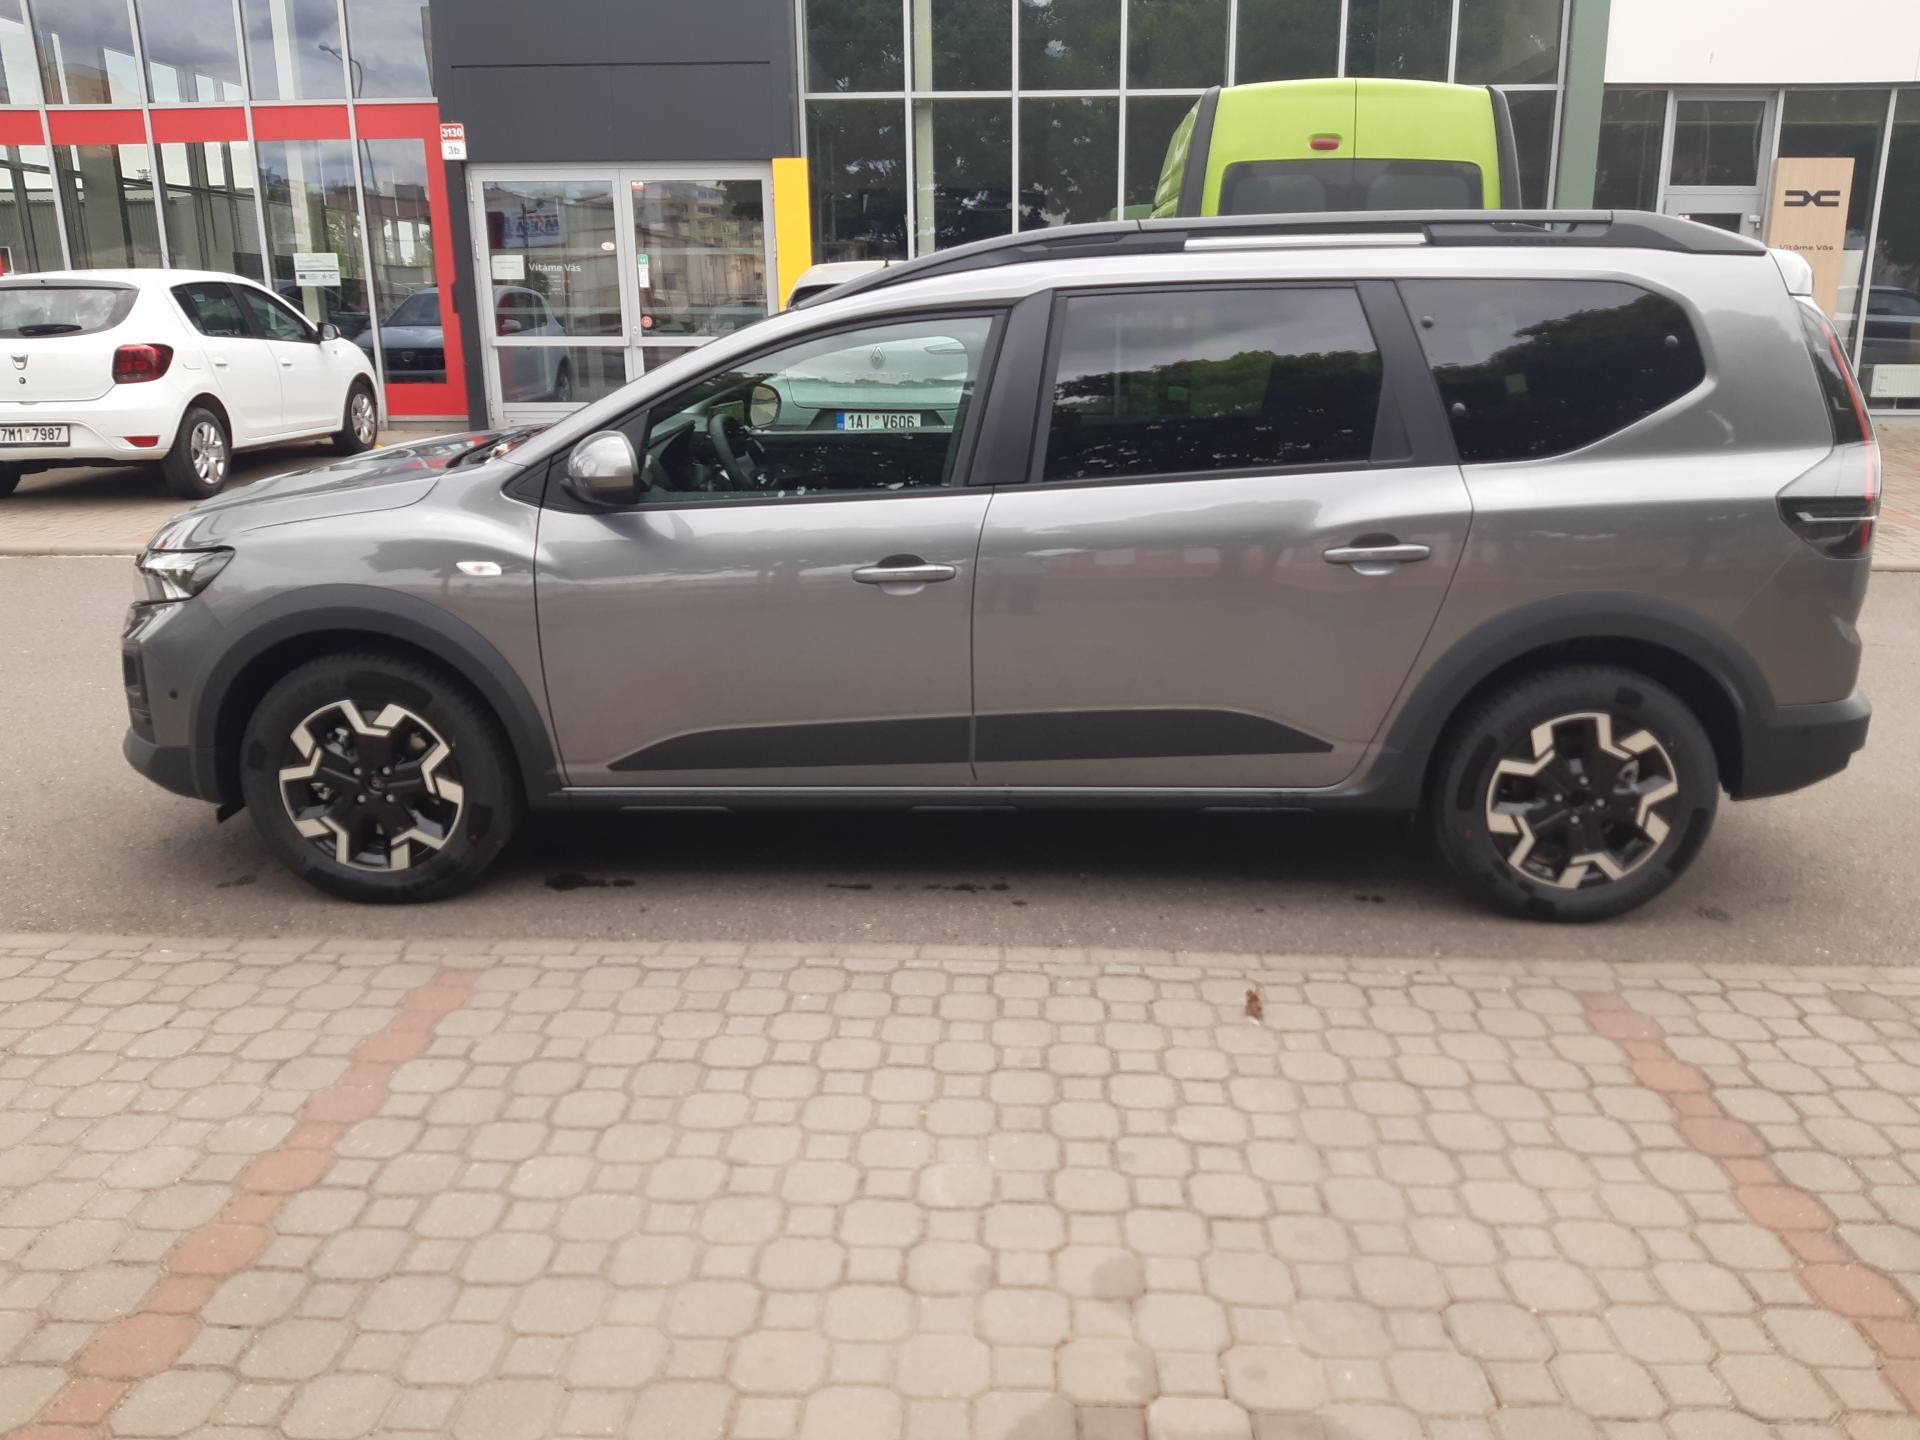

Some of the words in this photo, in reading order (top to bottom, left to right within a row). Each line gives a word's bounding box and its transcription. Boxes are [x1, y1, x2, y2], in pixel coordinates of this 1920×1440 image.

[441, 128, 462, 138] 3130
[448, 146, 460, 155] 3b
[563, 262, 582, 272] Vás
[882, 414, 915, 429] V606
[0, 427, 23, 441] 7M1
[32, 427, 62, 441] 7987
